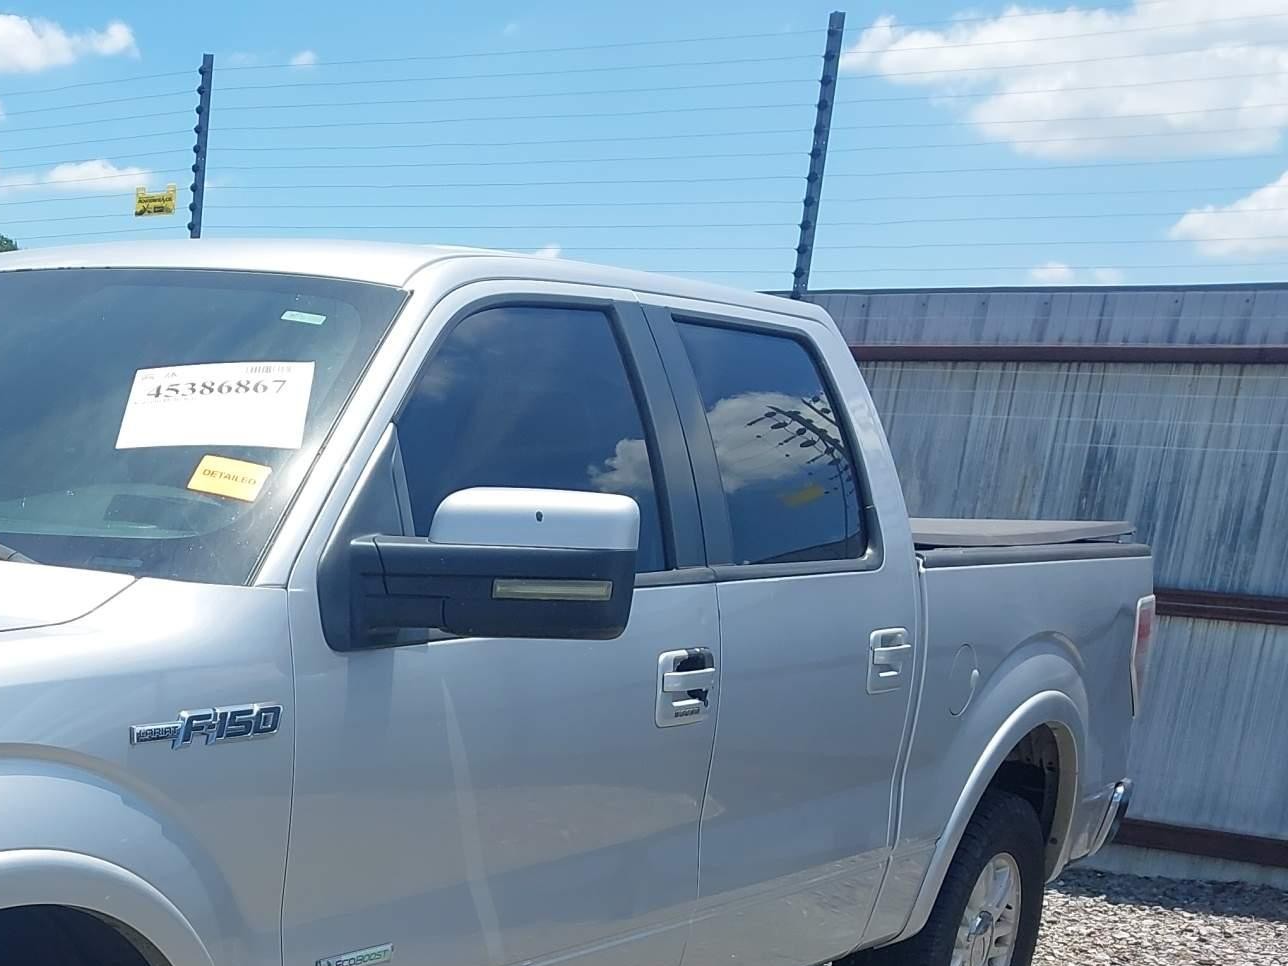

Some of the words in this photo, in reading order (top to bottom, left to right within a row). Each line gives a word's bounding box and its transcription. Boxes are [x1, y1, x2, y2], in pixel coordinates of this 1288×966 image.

[146, 379, 288, 399] 45386867
[202, 468, 257, 485] DETAILED
[177, 703, 283, 746] F-150
